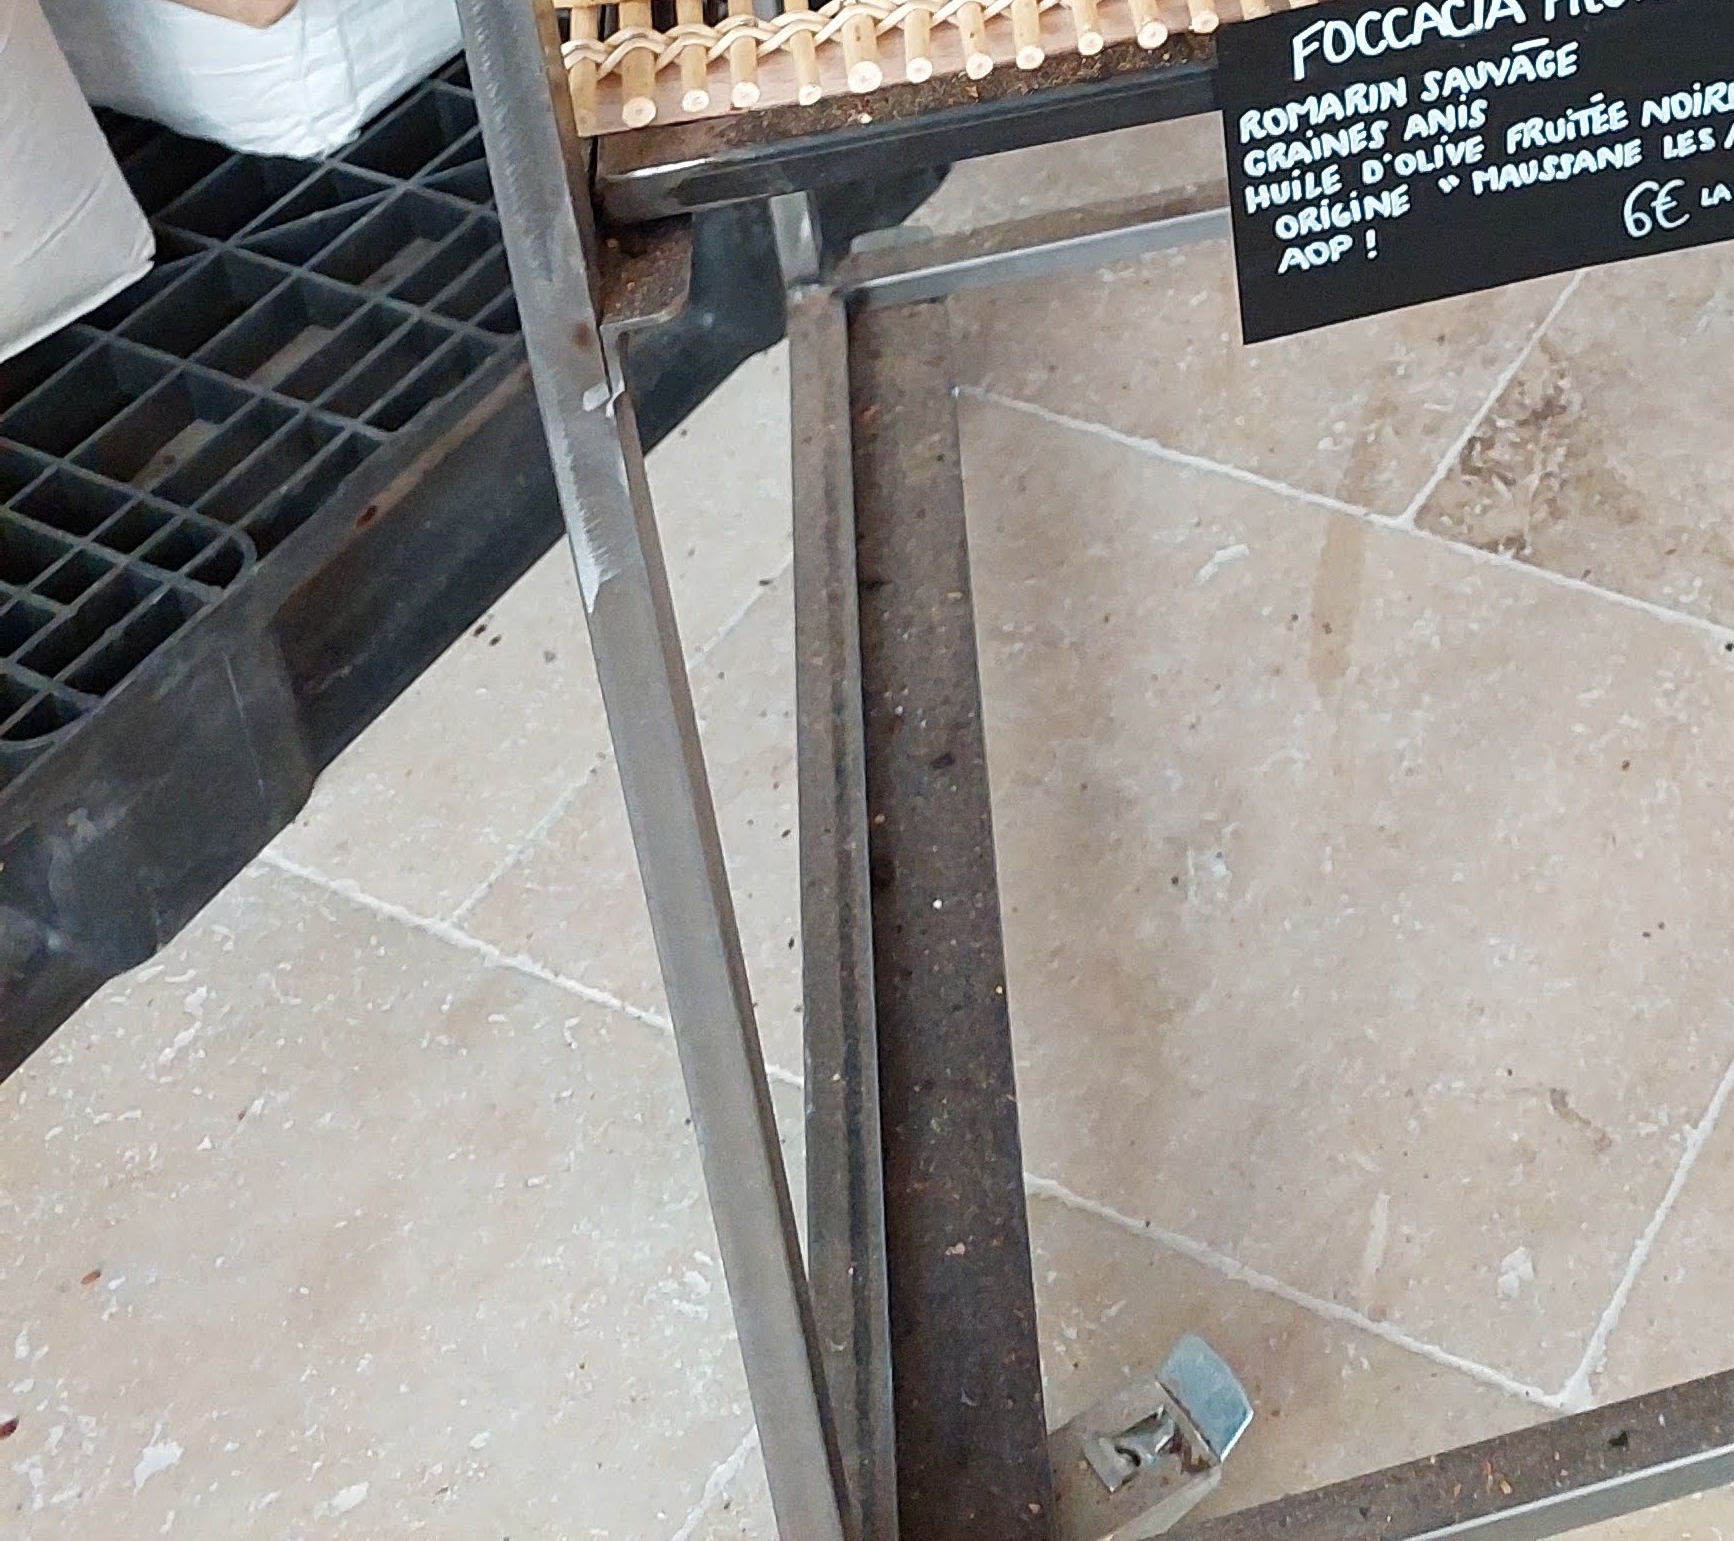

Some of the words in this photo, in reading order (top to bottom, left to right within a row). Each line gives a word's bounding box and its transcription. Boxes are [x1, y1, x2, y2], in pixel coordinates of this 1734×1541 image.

[1240, 77, 1407, 142] ROMARIN
[1423, 41, 1579, 98] SAUVAGE
[1663, 124, 1714, 159] LES
[1622, 180, 1692, 239] 6€
[1701, 182, 1734, 209] LA
[1278, 235, 1353, 275] AOP
